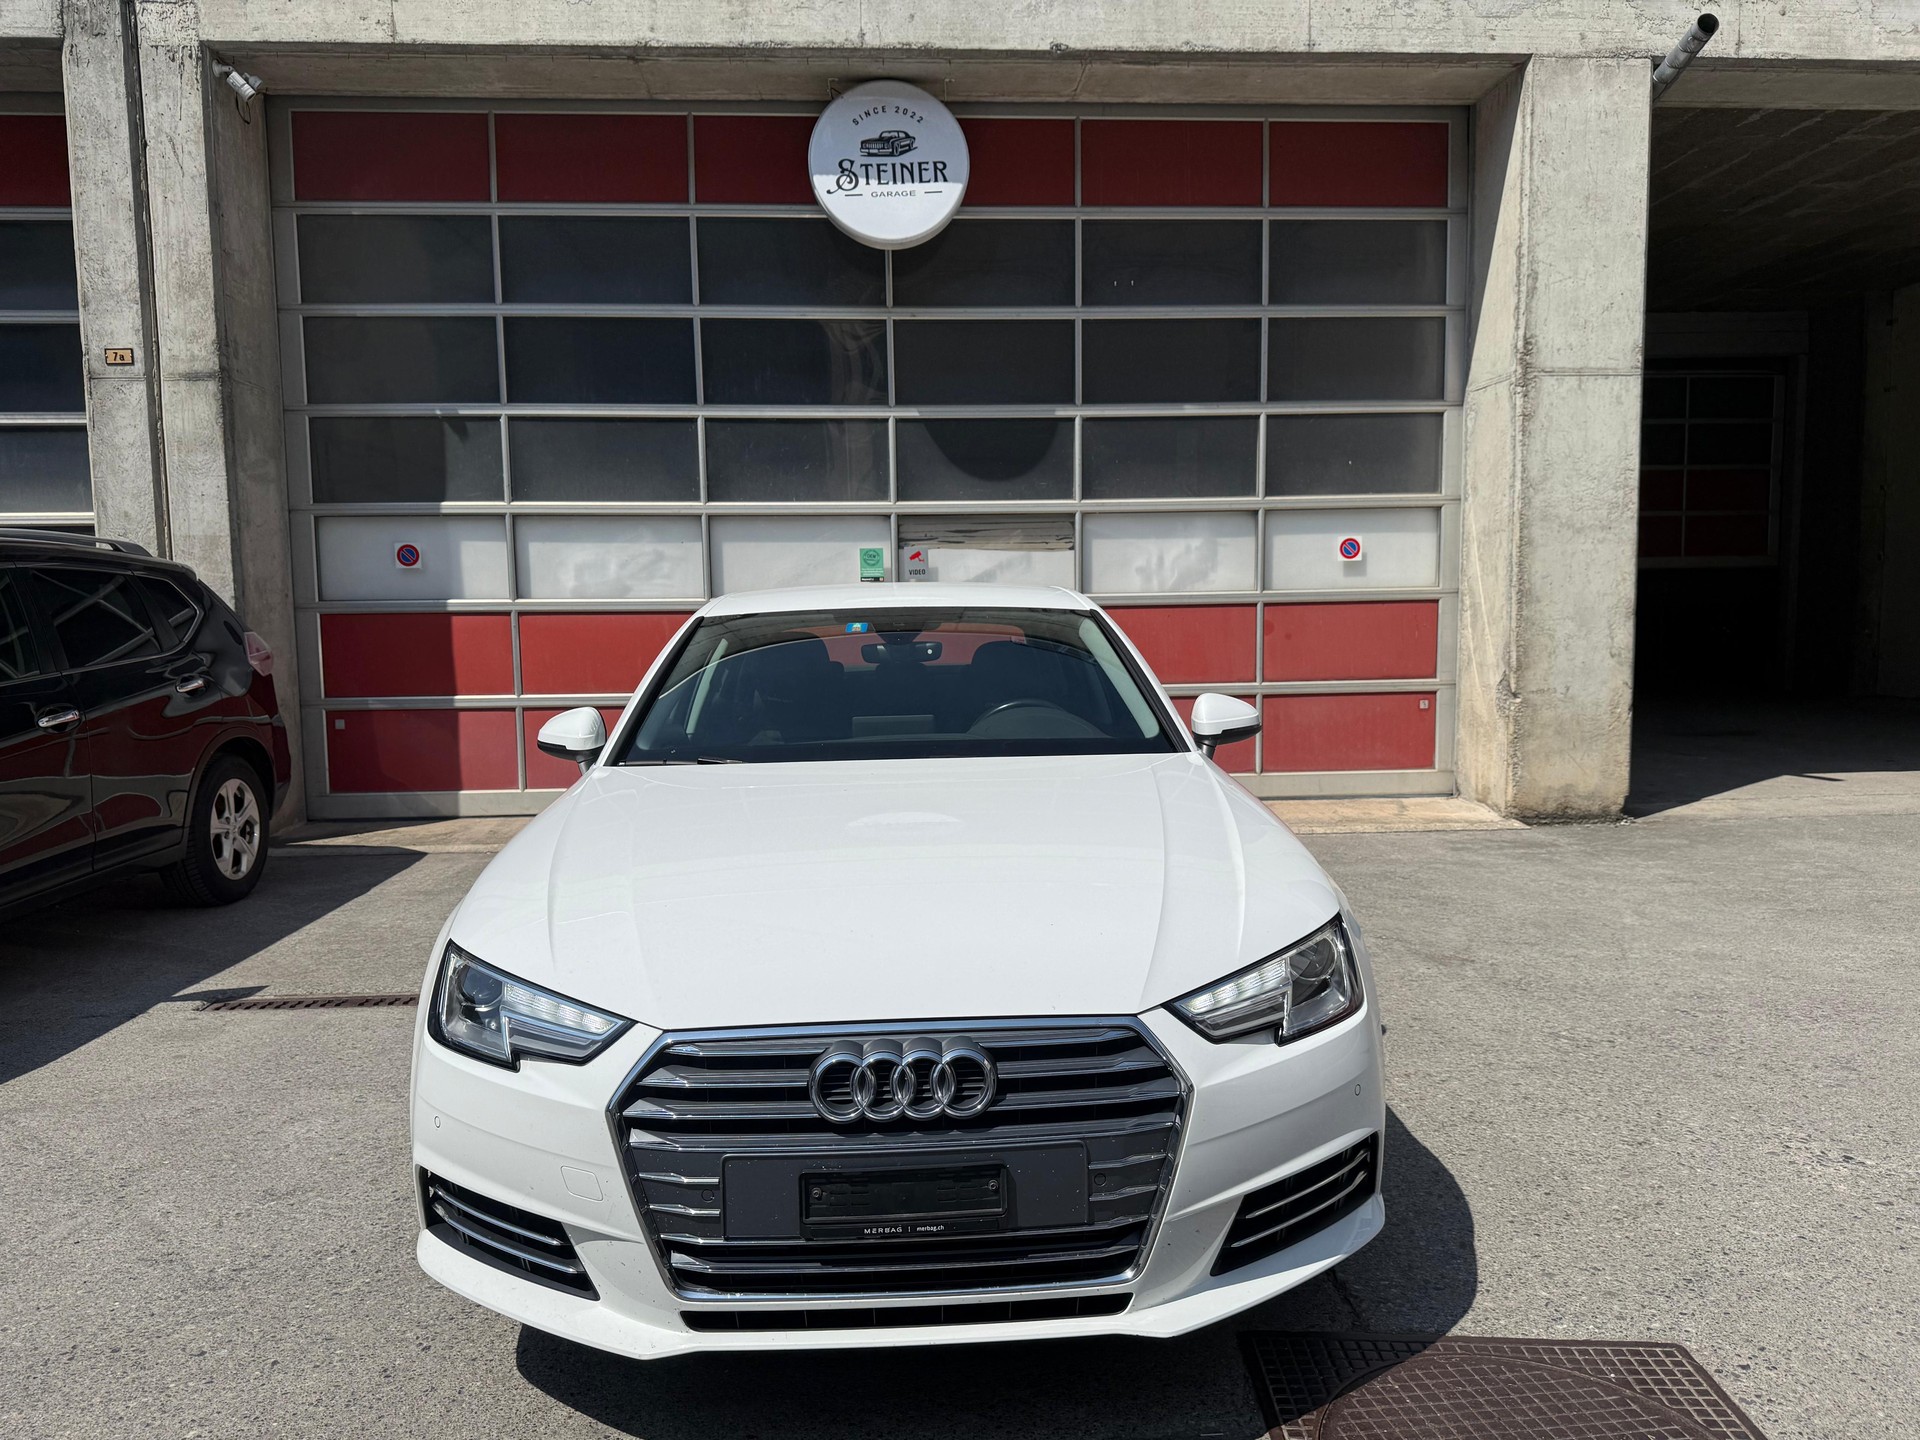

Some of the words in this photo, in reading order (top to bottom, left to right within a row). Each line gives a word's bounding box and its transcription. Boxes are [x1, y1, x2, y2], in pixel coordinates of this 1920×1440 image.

[852, 105, 888, 126] SINCE
[894, 105, 924, 124] 2022
[826, 158, 948, 194] STEINER
[113, 352, 125, 361] 7a
[908, 568, 926, 576] VIDEO
[863, 1226, 903, 1234] MERBAG
